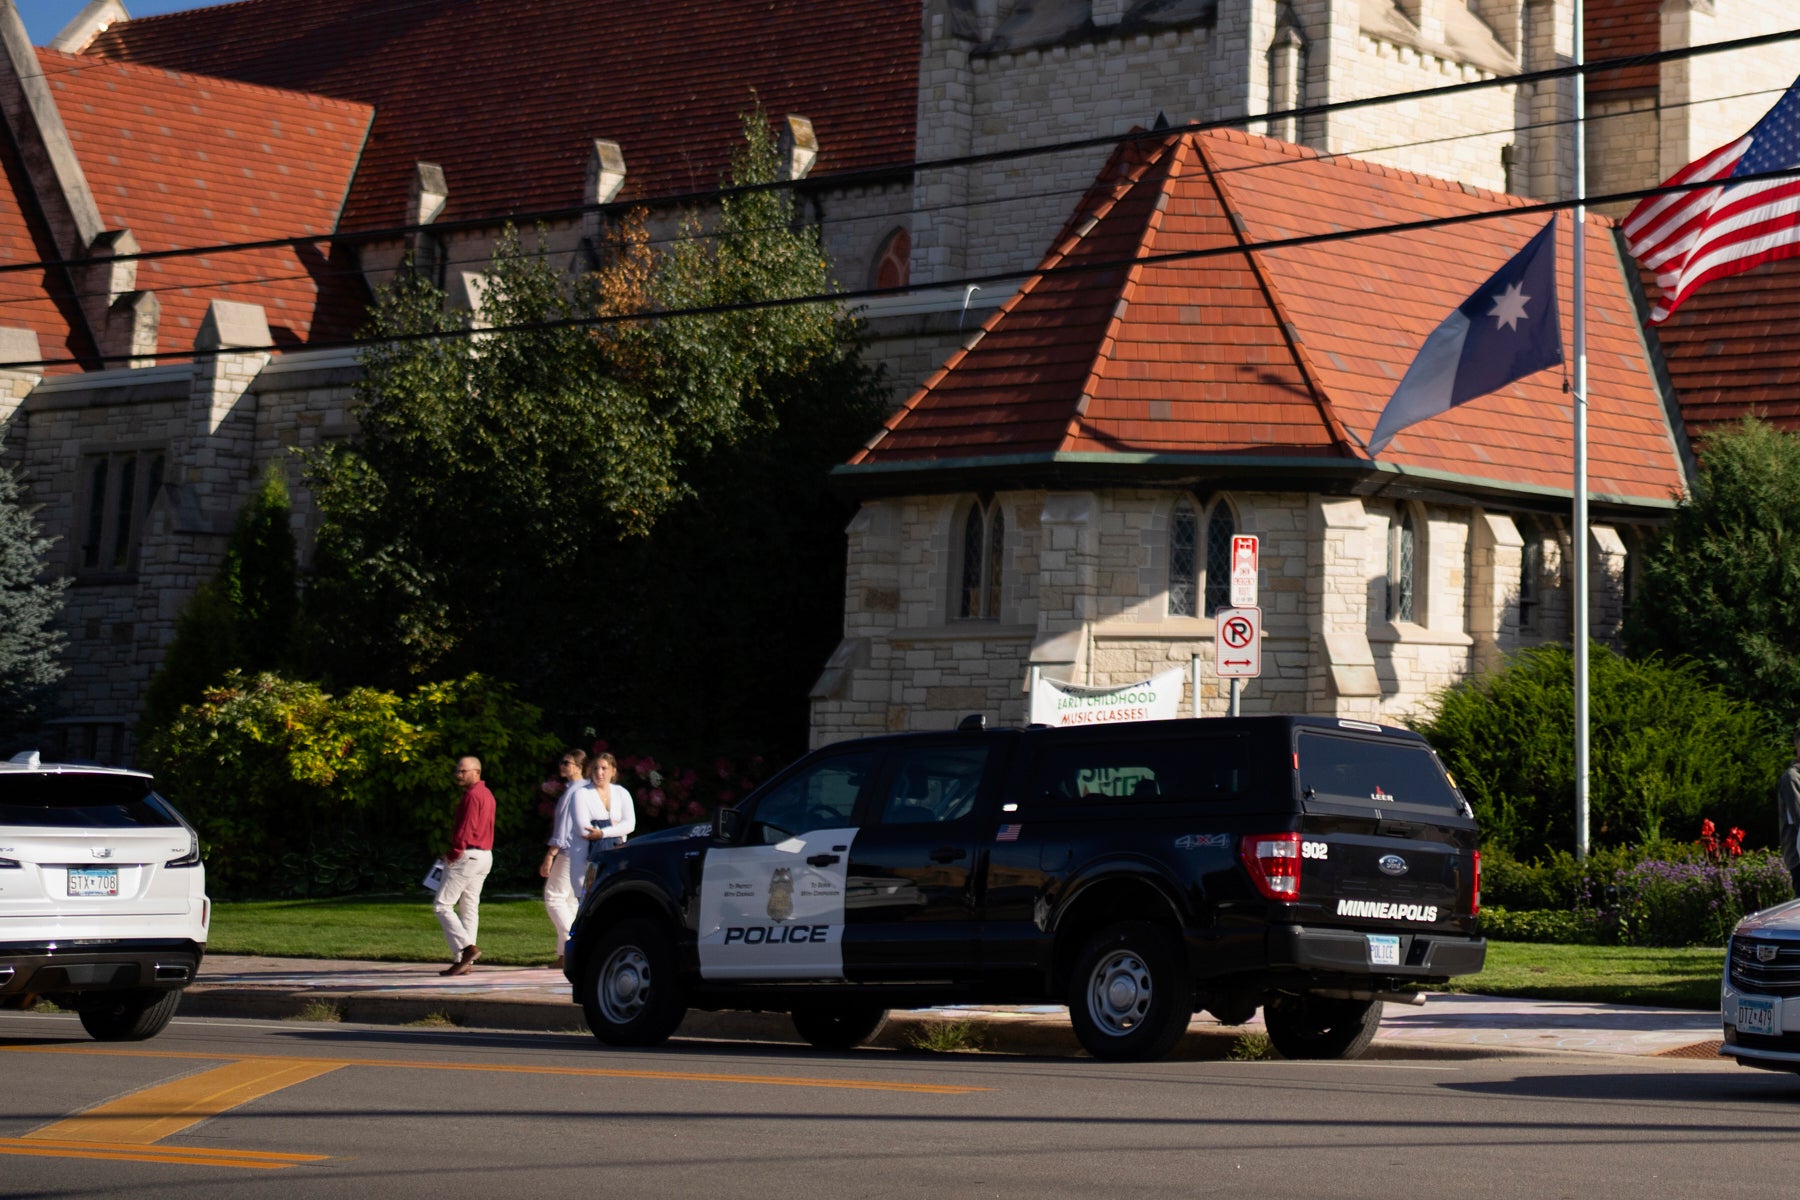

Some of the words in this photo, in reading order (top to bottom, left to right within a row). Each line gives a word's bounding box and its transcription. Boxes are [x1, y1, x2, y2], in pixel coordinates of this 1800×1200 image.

[1057, 696, 1083, 710] EARLY
[1086, 692, 1157, 708] CHILDHOOD
[1061, 711, 1093, 725] MUSIC
[1096, 707, 1149, 722] CLASSES!
[1371, 793, 1394, 802] LEER
[690, 825, 712, 837] 902
[1301, 842, 1328, 860] 902
[71, 876, 90, 890] STX
[97, 876, 116, 890] 708
[1337, 899, 1438, 922] MINNEAPOLIS
[724, 925, 829, 945] POLICE
[1369, 944, 1394, 960] POLICE
[1738, 1006, 1754, 1024] DTZ
[1758, 1008, 1772, 1027] 479
